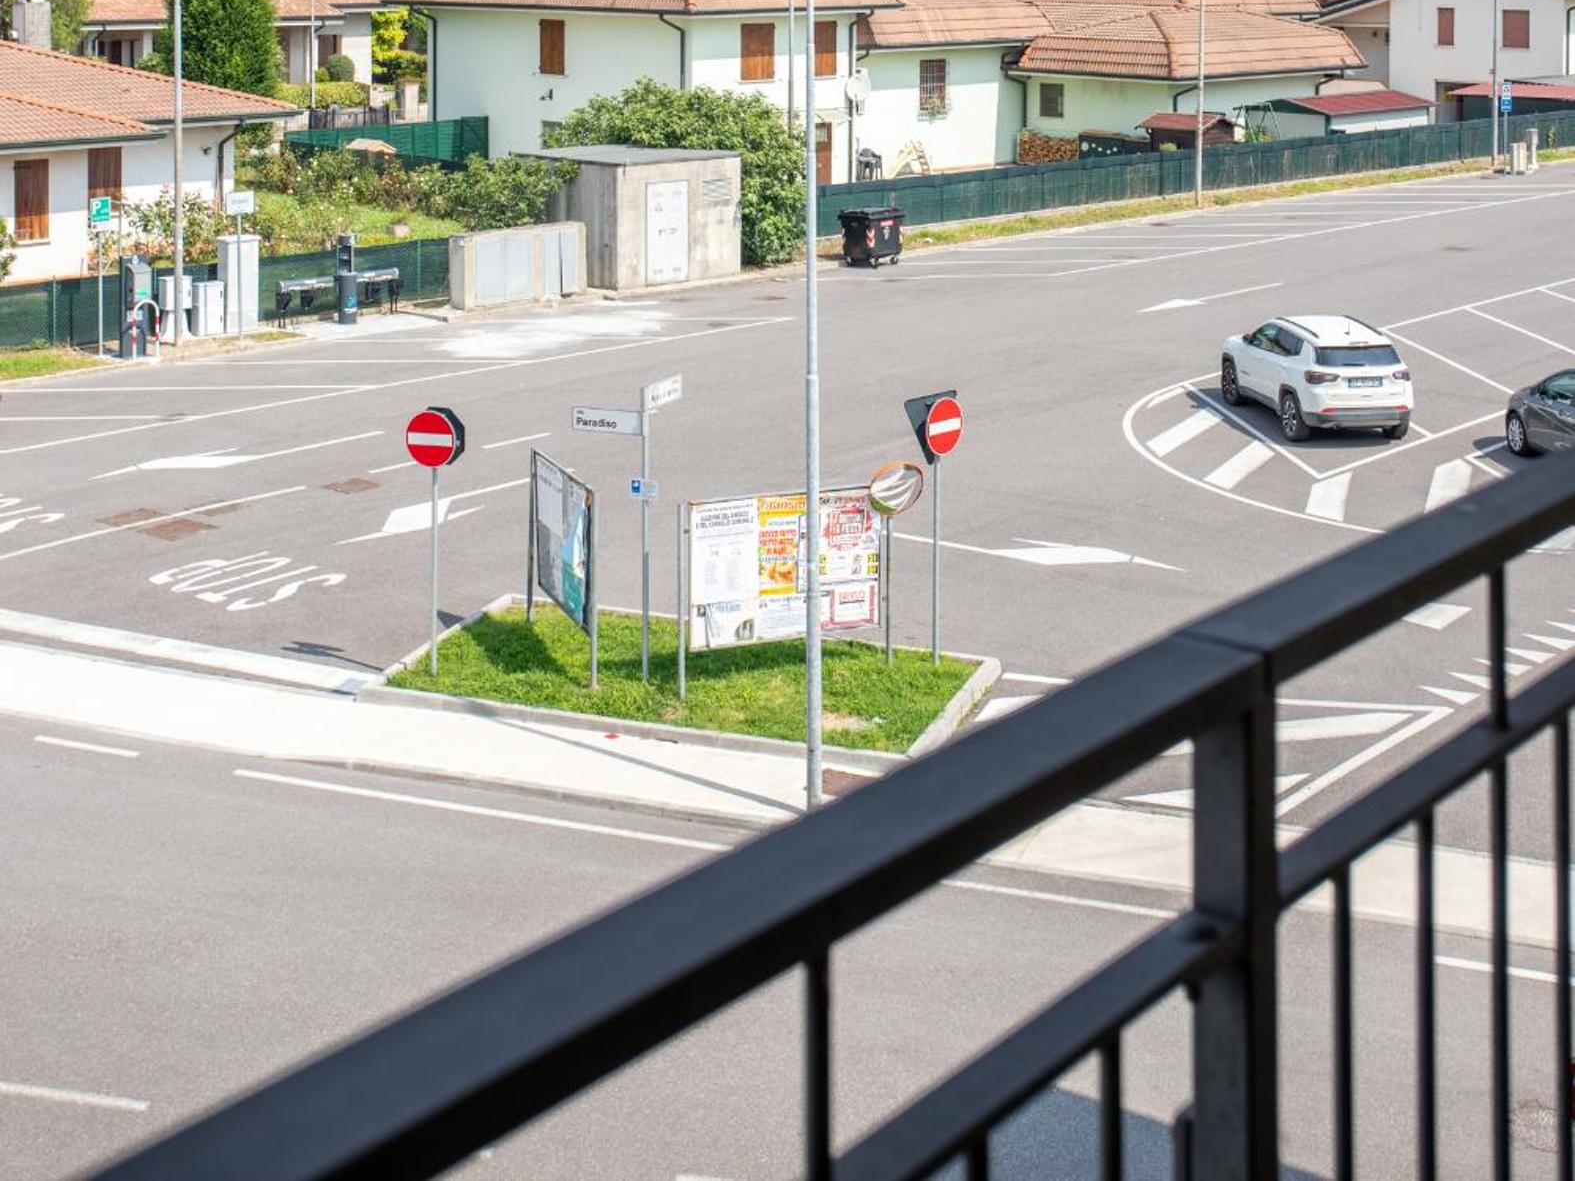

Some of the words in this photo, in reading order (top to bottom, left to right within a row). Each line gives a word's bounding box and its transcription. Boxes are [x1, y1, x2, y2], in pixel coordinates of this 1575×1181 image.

[93, 201, 101, 215] P
[576, 416, 617, 429] Paradiso
[149, 550, 347, 612] STOP
